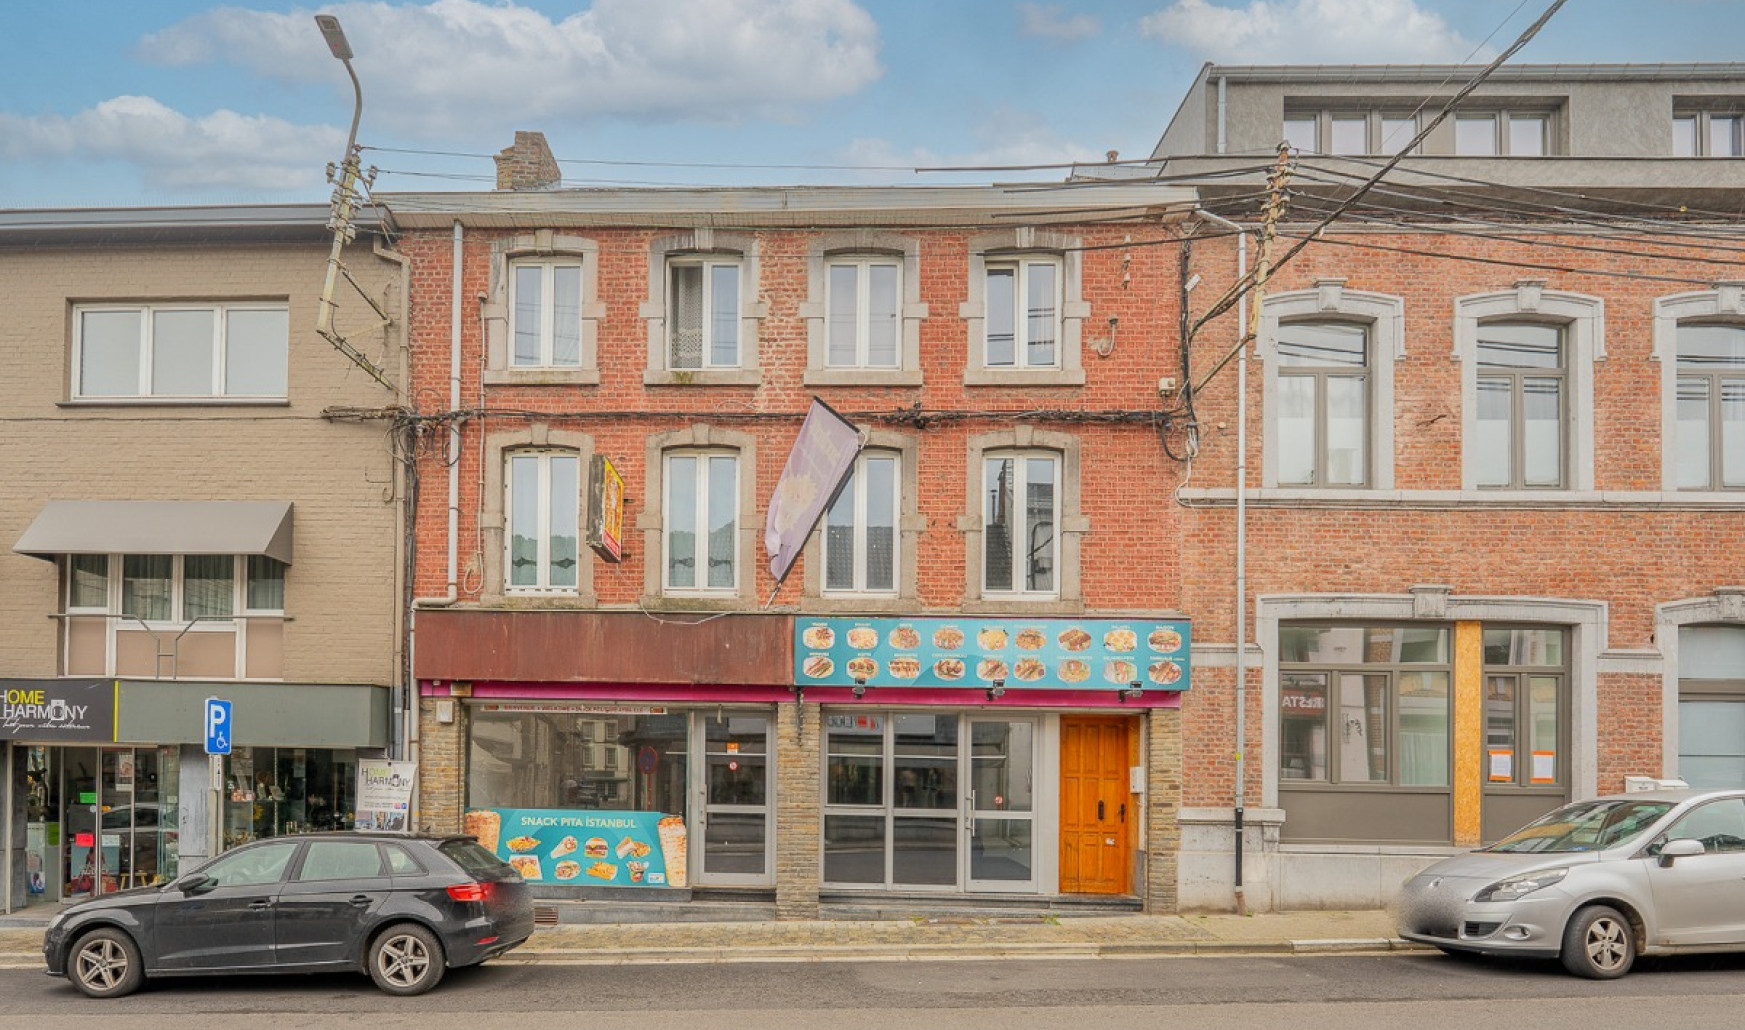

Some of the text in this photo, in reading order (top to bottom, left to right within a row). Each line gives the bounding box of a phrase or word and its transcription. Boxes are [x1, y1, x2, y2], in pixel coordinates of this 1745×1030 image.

[0, 689, 45, 705] HOME
[209, 704, 226, 738] P
[521, 815, 637, 829] SNACK PITA İSTANBUL
